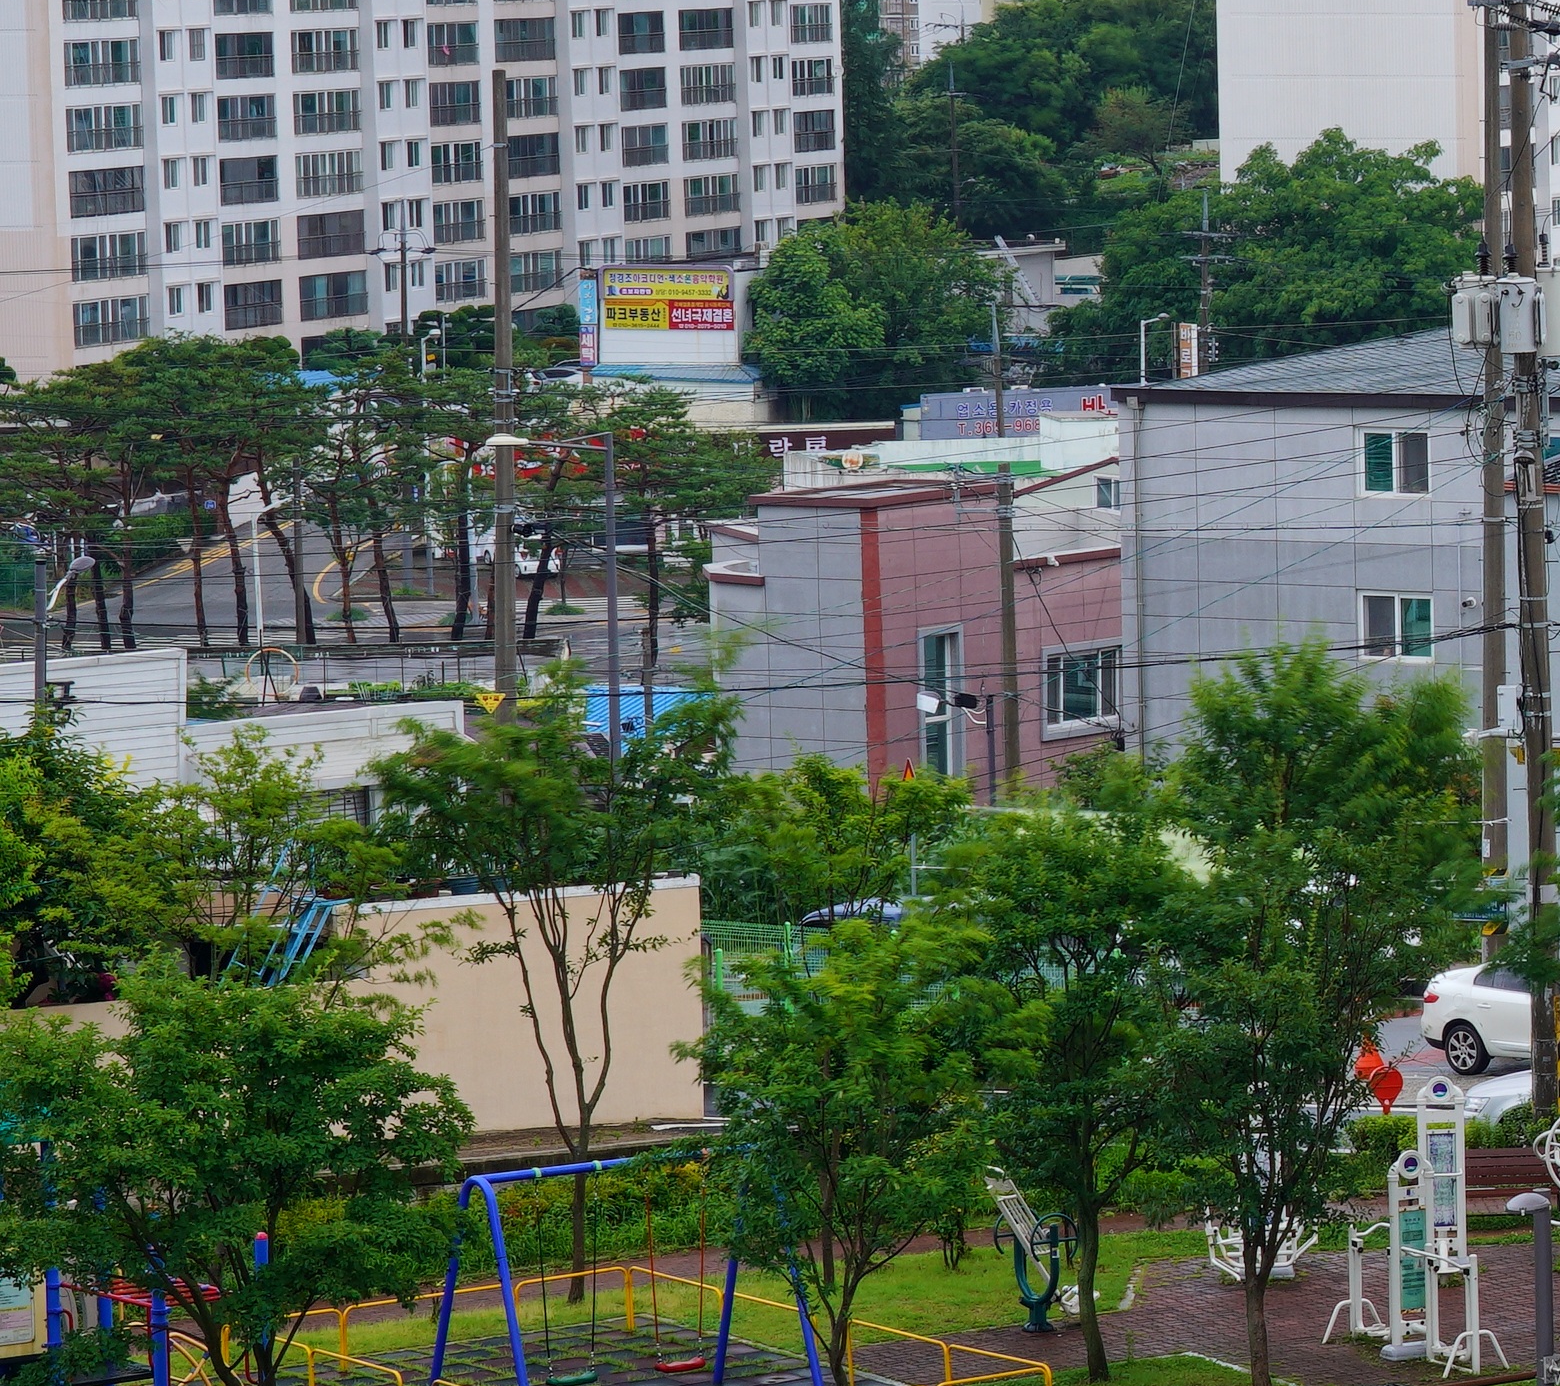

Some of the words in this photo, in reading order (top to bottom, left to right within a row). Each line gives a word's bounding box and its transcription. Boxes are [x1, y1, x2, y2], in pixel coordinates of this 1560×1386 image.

[606, 307, 661, 322] 파크부동산
[671, 308, 733, 323] 선녀국제결혼
[581, 334, 594, 361] 세탁
